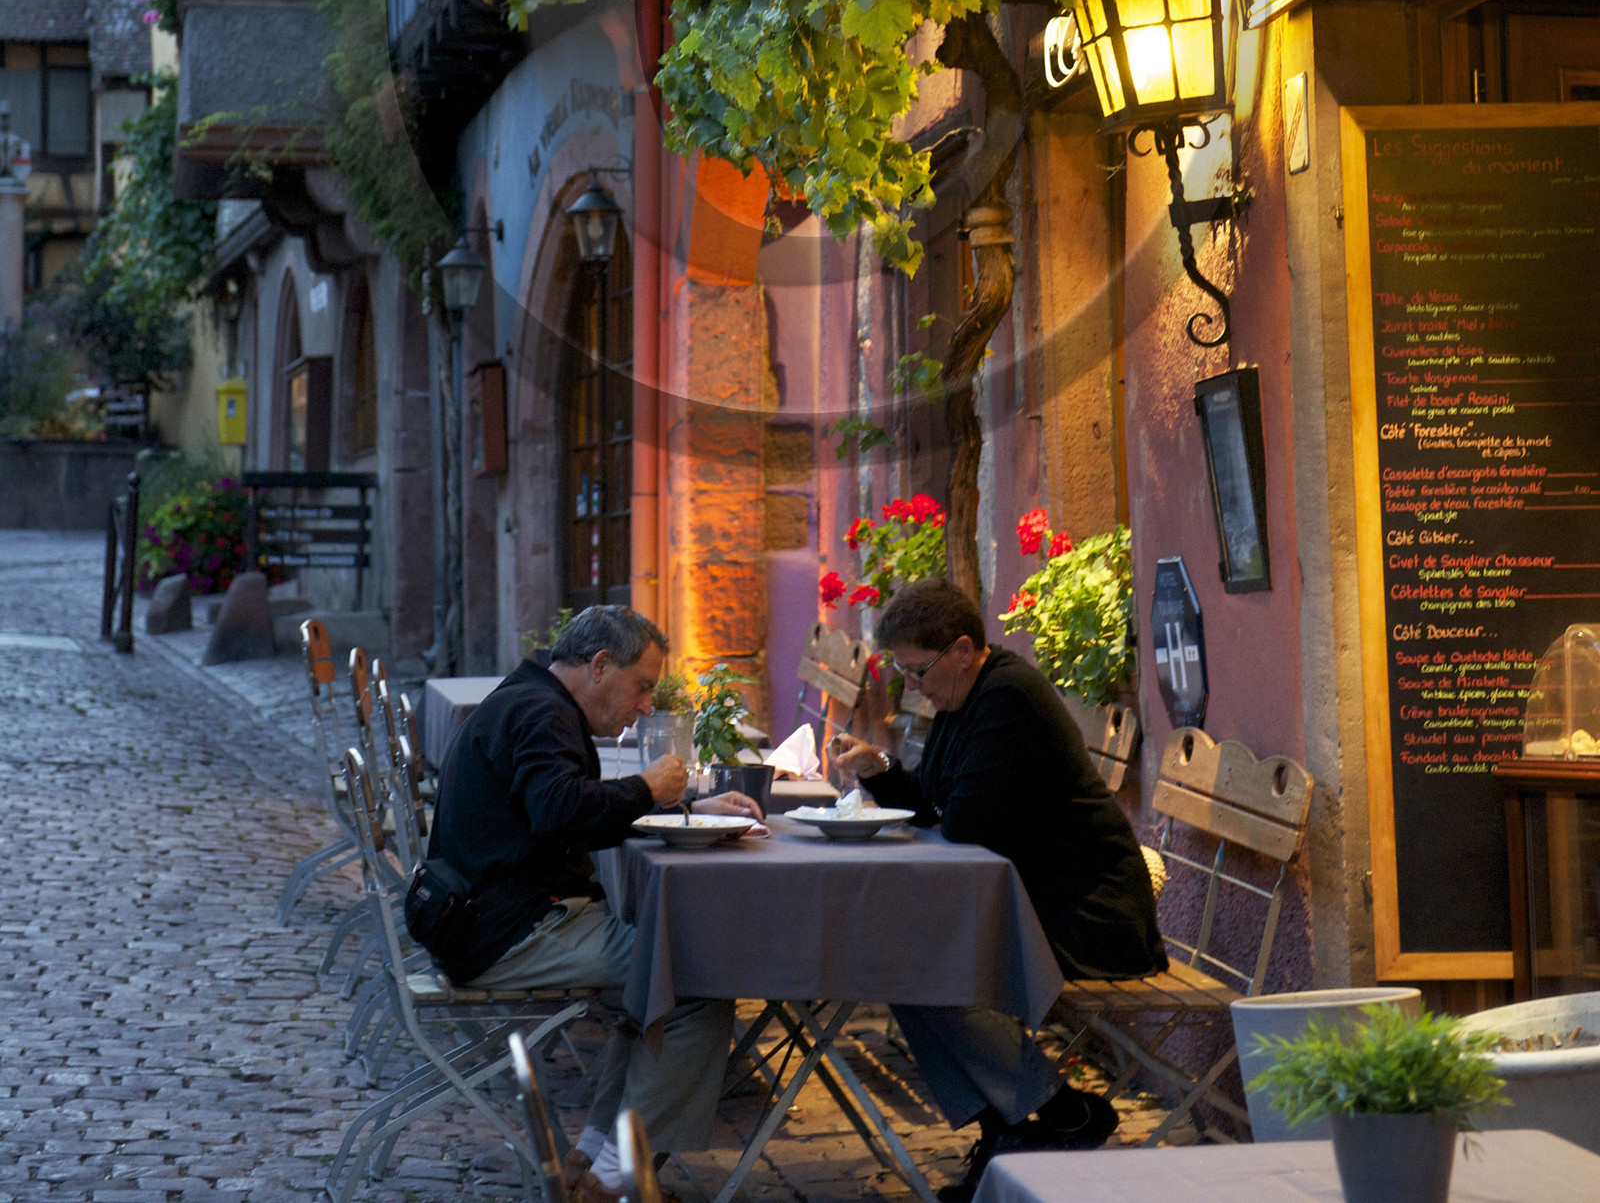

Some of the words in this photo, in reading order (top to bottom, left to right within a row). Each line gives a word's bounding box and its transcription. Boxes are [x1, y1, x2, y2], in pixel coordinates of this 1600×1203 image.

[1374, 138, 1401, 157] Les
[1411, 133, 1514, 166] Suggestions
[1462, 159, 1478, 176] du
[1411, 290, 1426, 304] de
[1441, 344, 1455, 357] de
[1387, 394, 1411, 408] Filet
[1412, 394, 1427, 407] de
[1467, 390, 1511, 406] Rossini
[1379, 421, 1407, 440] Côté
[1501, 435, 1515, 448] de
[1382, 466, 1436, 481] Cassolette
[1385, 499, 1428, 515] Escalope
[1429, 497, 1442, 511] de
[1386, 529, 1414, 546] Côté
[1388, 553, 1419, 569] Civet
[1422, 553, 1437, 568] de
[1440, 553, 1493, 574] Sanglier
[1494, 553, 1556, 568] Chasseur
[1390, 583, 1454, 600] Côtelettes
[1458, 584, 1474, 598] de
[1476, 584, 1528, 602] Sanglier
[1392, 621, 1422, 641] Côté
[1395, 650, 1431, 667] Soupe
[1431, 650, 1446, 664] de
[1437, 675, 1452, 689] de
[1456, 674, 1510, 689] Mirabelle
[1403, 731, 1447, 747] Strudel
[1453, 733, 1475, 744] aux
[1399, 750, 1448, 766] Fondant
[1451, 751, 1470, 763] au
